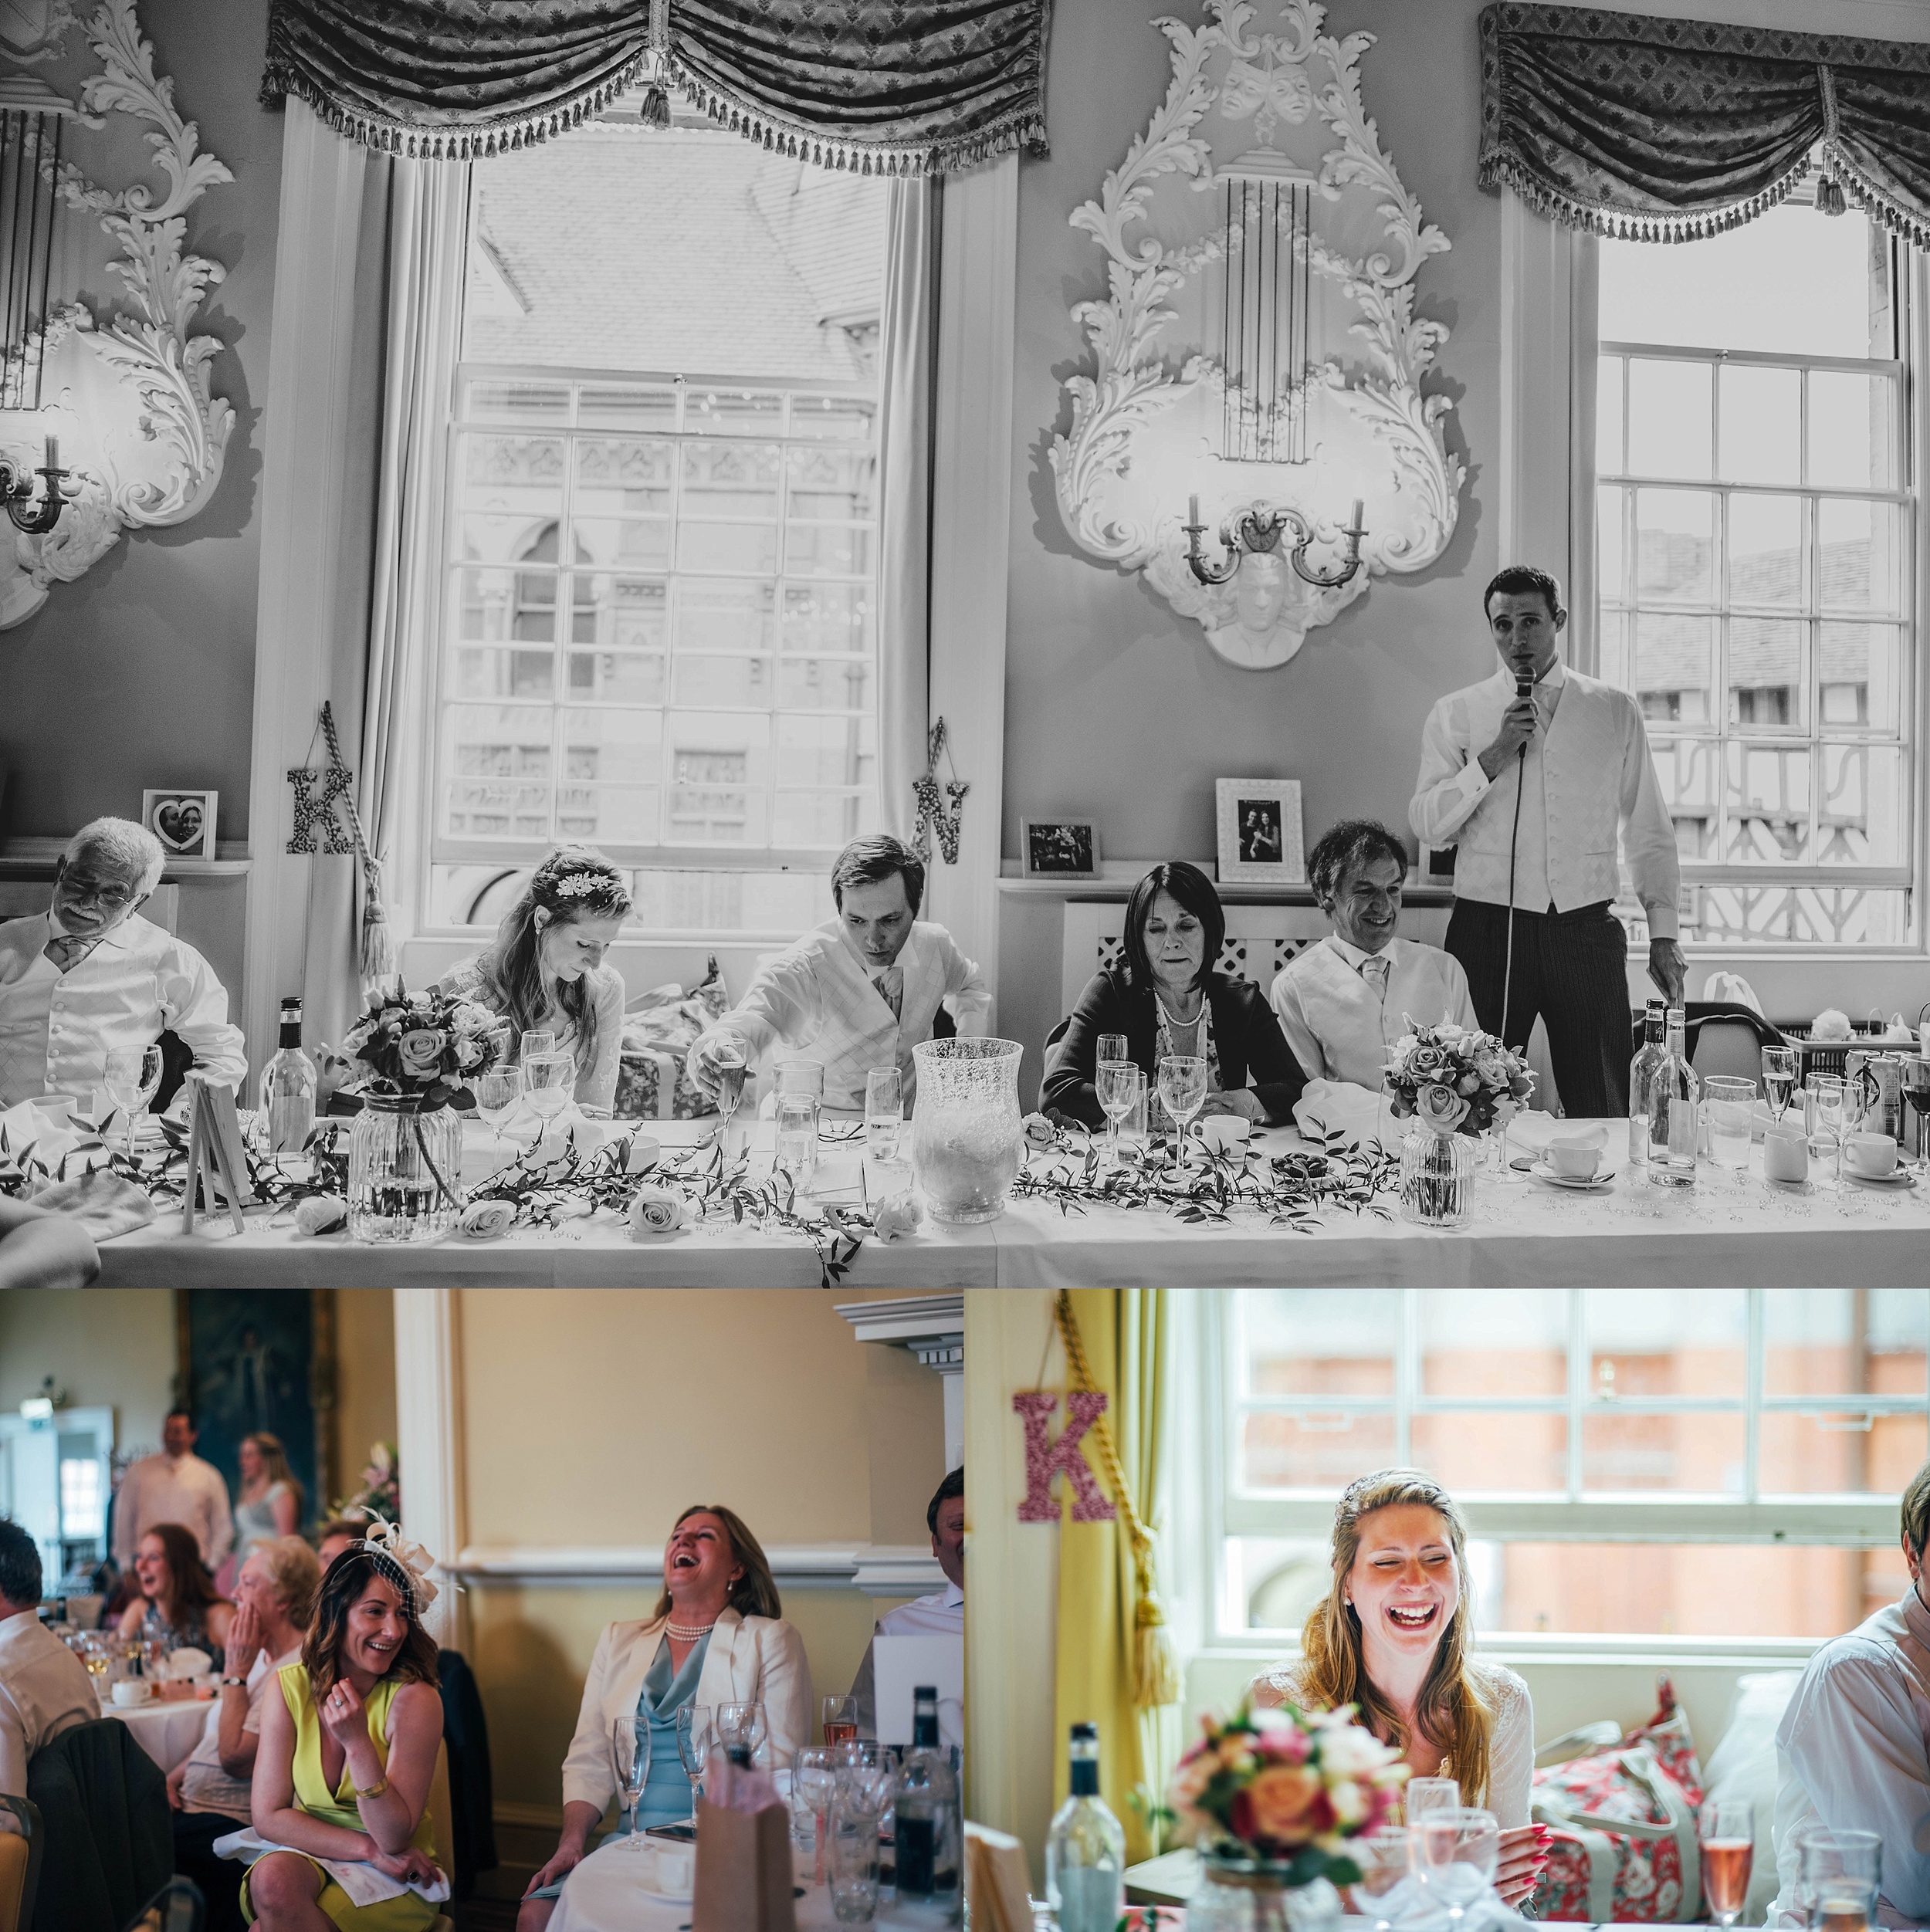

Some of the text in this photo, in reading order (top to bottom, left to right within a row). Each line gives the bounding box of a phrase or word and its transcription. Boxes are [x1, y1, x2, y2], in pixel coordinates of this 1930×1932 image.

[286, 770, 355, 854] K
[911, 781, 970, 864] N
[1012, 1392, 1116, 1522] K
